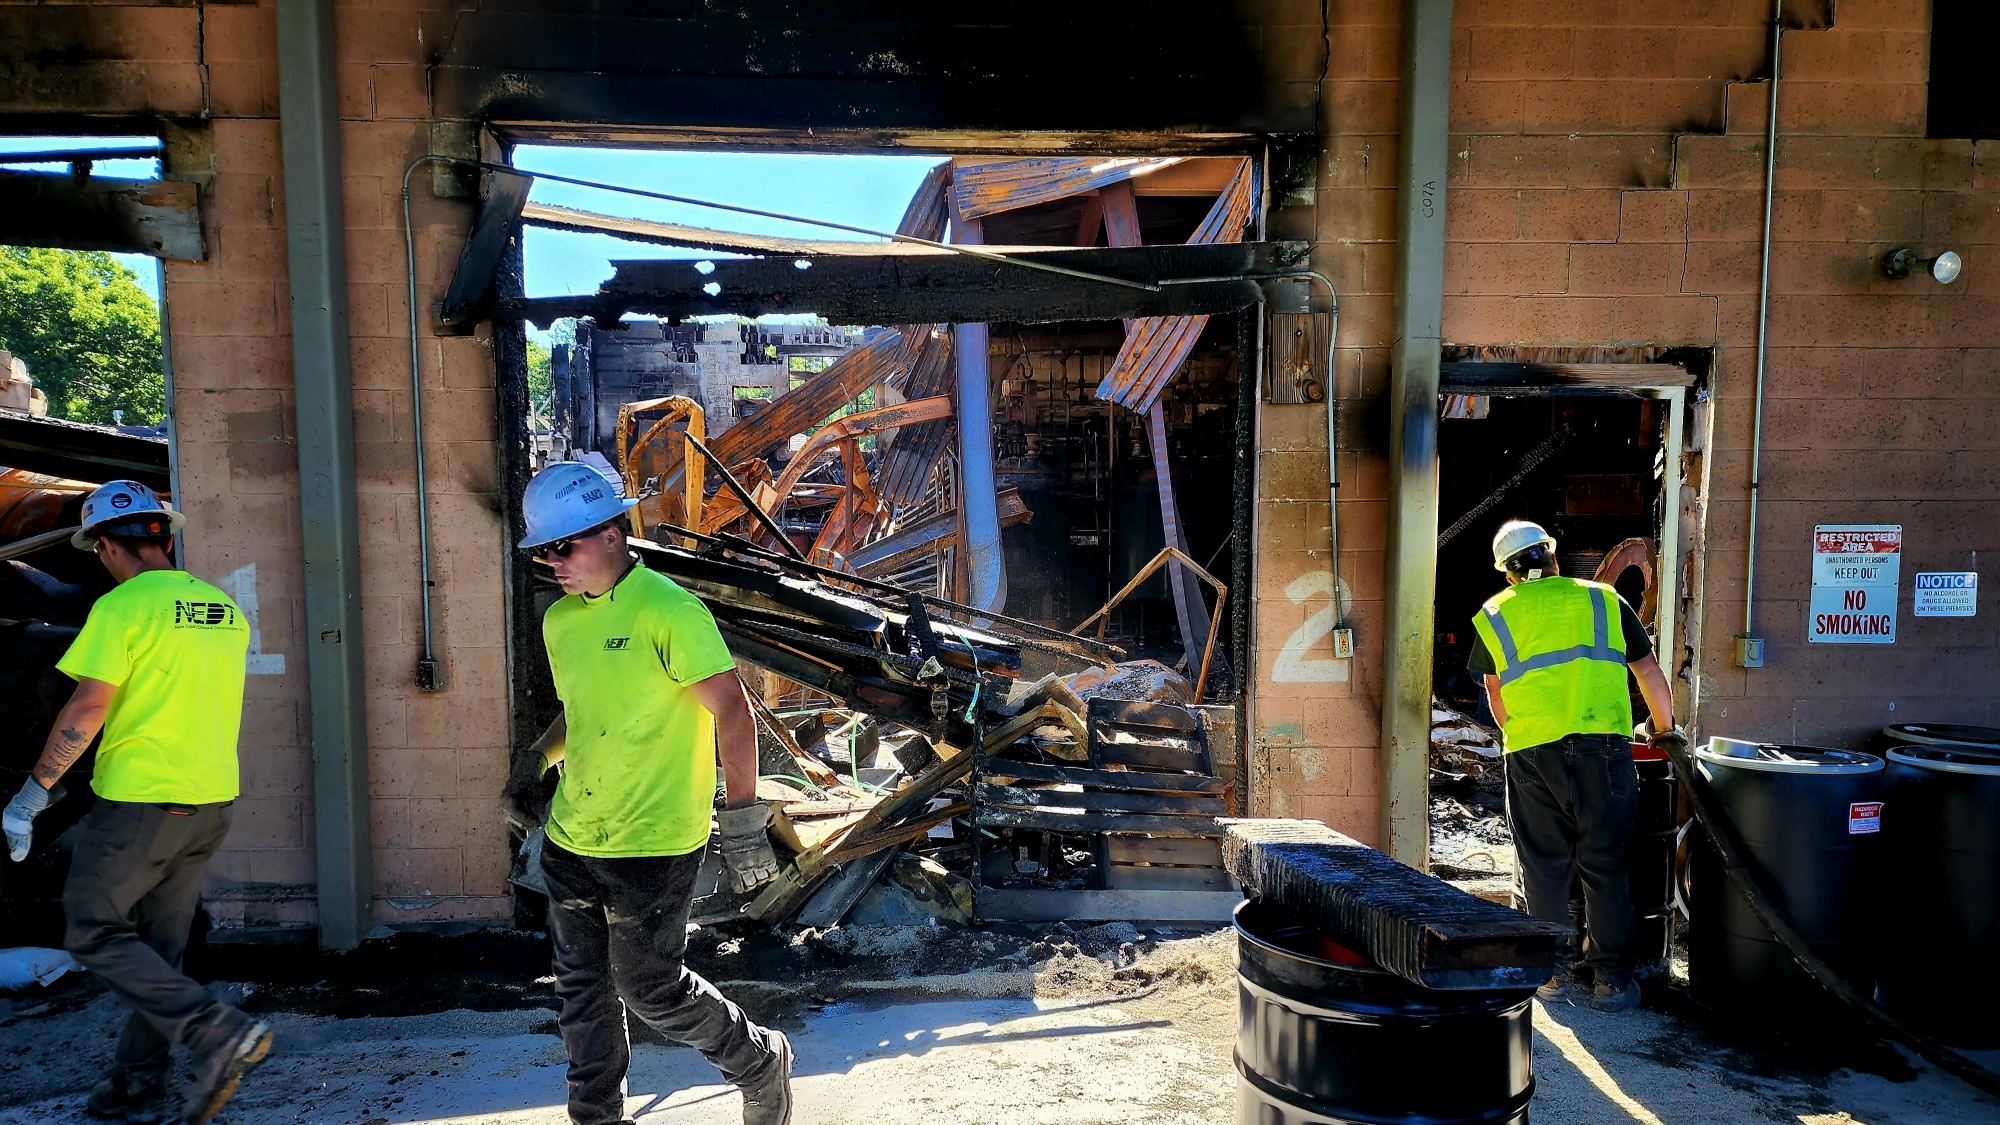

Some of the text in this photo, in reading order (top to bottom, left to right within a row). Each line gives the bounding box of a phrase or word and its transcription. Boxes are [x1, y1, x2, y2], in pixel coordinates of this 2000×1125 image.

[1820, 533, 1897, 542] RESTRICTED
[1841, 543, 1875, 552] AREA
[1835, 567, 1879, 579] KEEP OUT
[1920, 575, 1973, 588] NOTICE
[1843, 590, 1867, 611] NO
[175, 600, 235, 625] NEDT
[1272, 570, 1352, 682] 2
